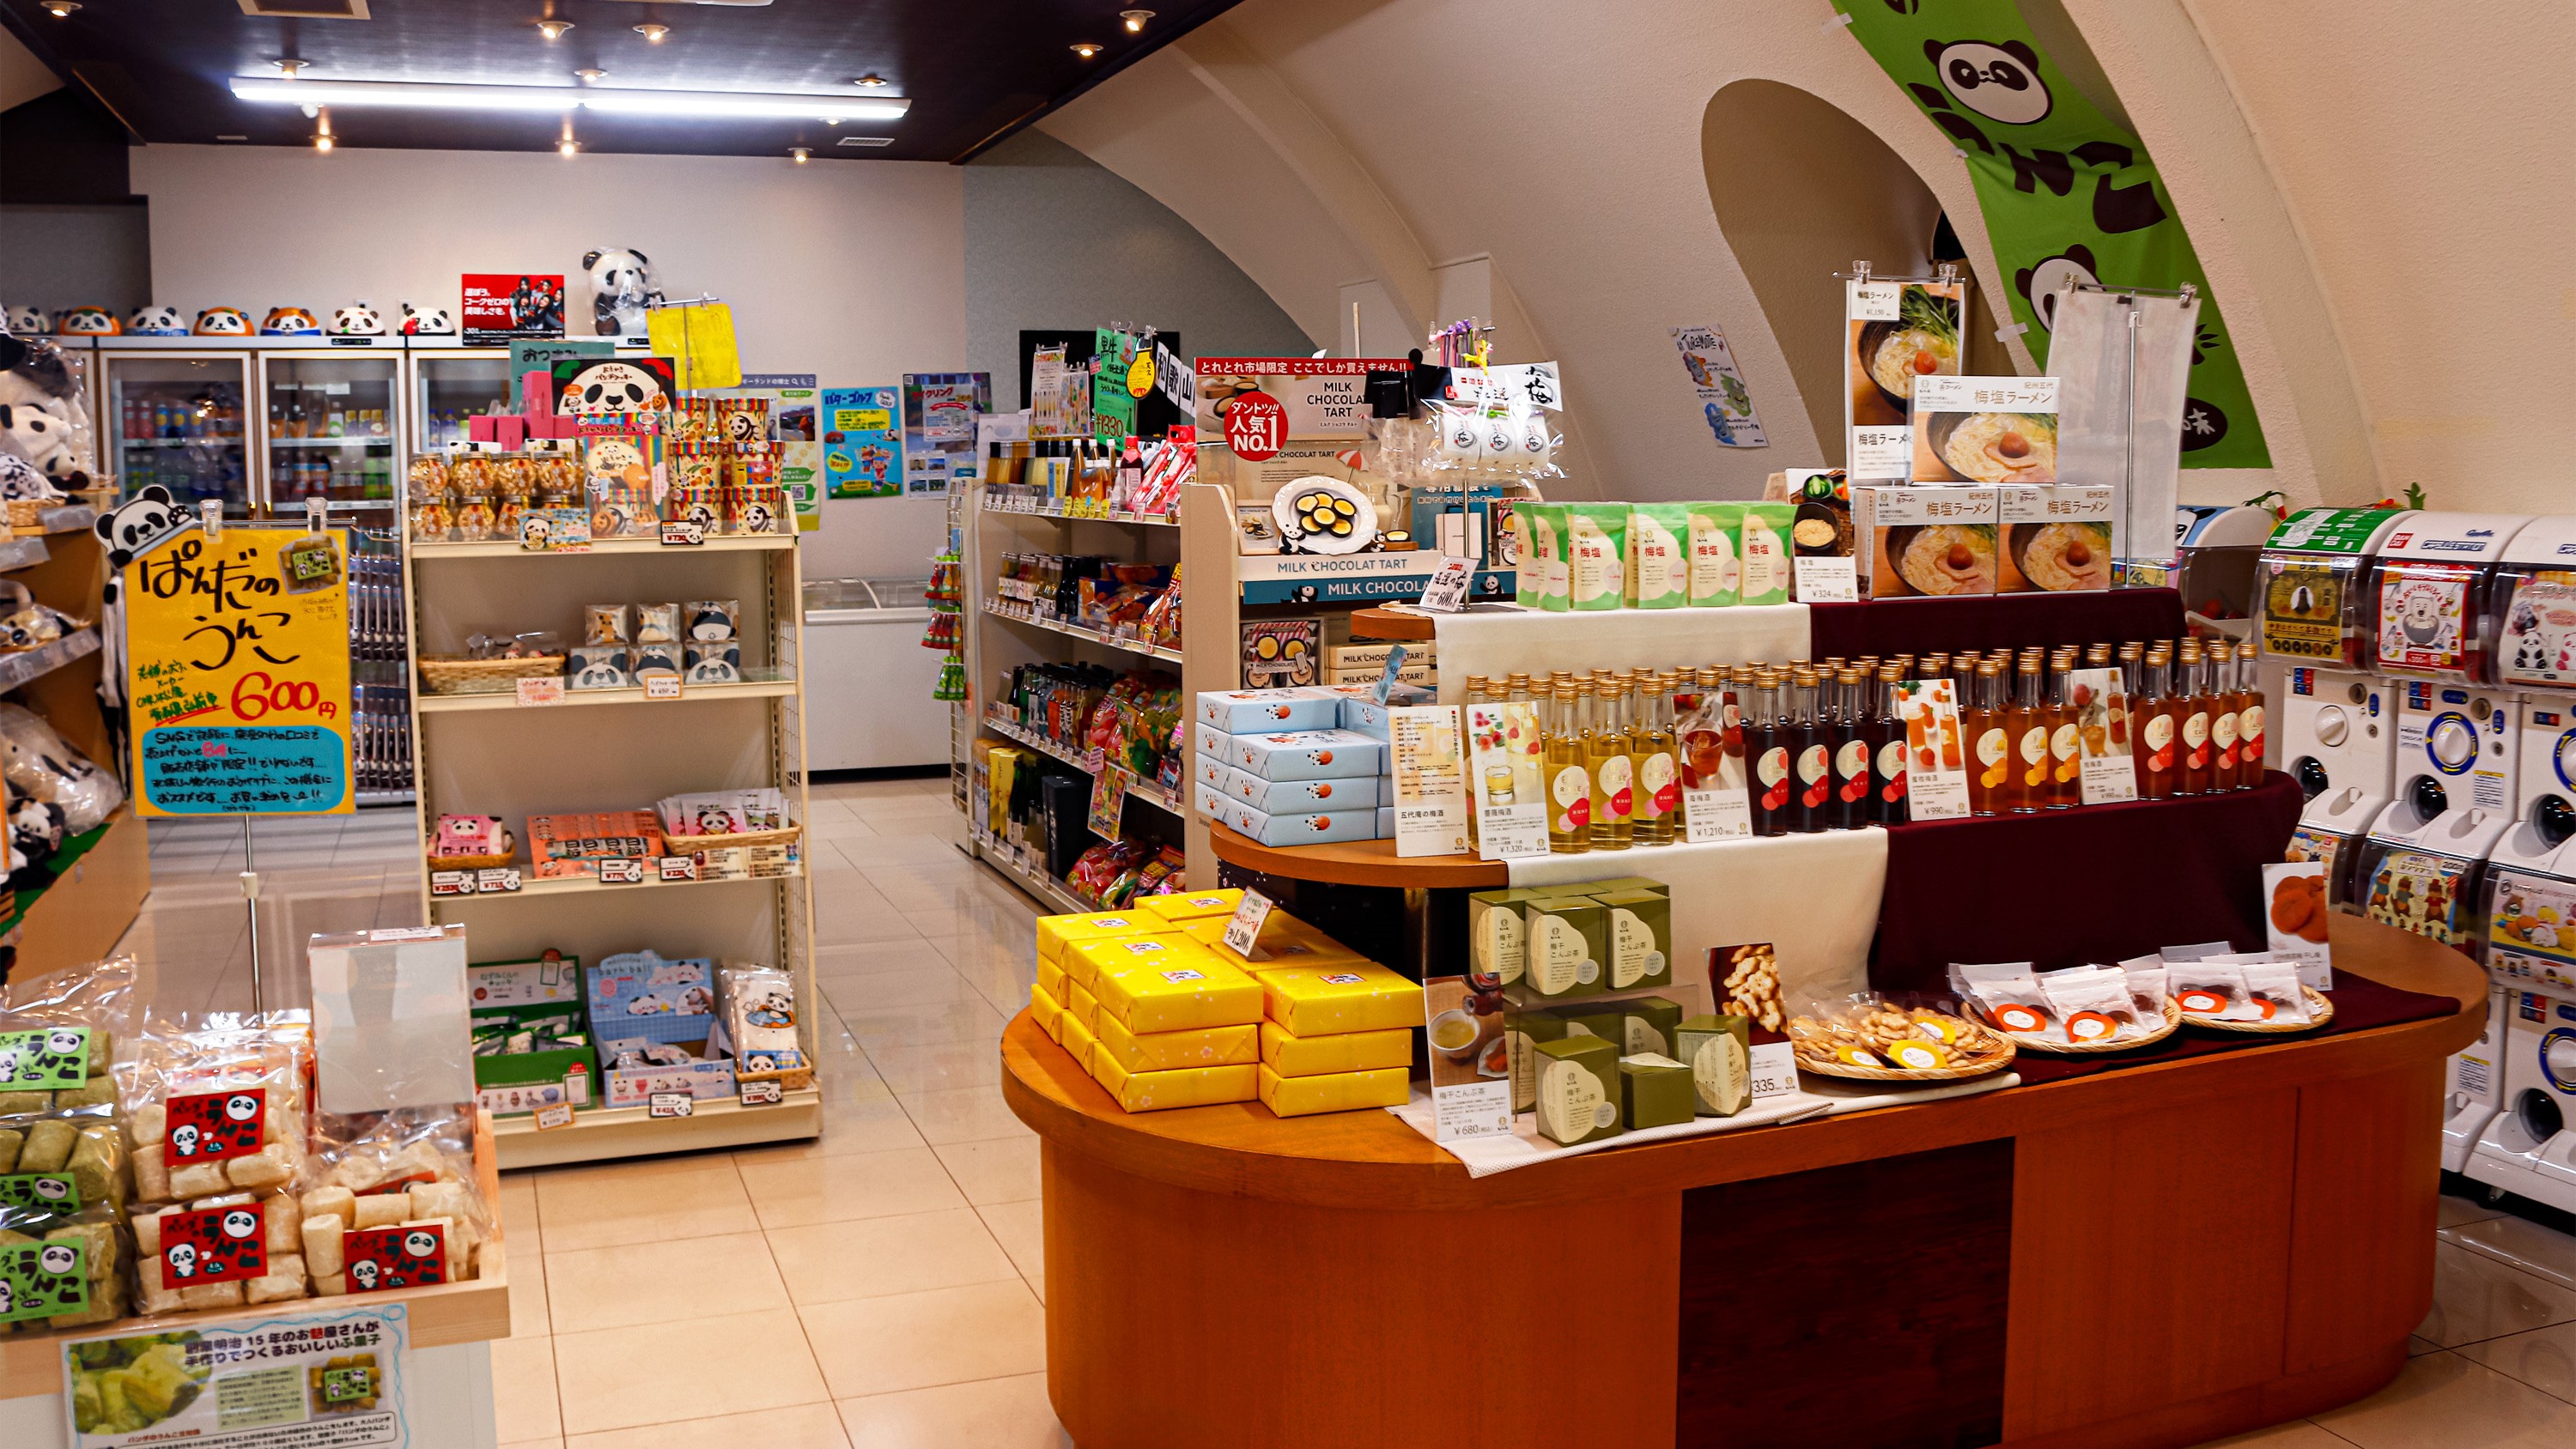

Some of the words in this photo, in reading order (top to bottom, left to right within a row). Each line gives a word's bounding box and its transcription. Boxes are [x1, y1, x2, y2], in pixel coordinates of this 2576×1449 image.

[1857, 291, 1893, 300] 梅塩ラーメン
[1200, 361, 1288, 373] とれとれ市場限定
[1323, 382, 1352, 392] MILK
[824, 391, 873, 406] パターゴルフ
[1307, 394, 1366, 405] CHOCOLA
[1974, 389, 2052, 404] 梅塩ラーメン
[1230, 402, 1279, 415] ダントツ!!
[1323, 407, 1352, 417] TART
[1230, 415, 1267, 433] 人気
[1926, 501, 1992, 516] 梅塩ラーメン
[2047, 500, 2108, 515] 梅塩ラーメン
[1580, 547, 1601, 558] 梅塩
[1644, 546, 1666, 557] 梅塩
[1698, 545, 1718, 555] 梅塩
[1749, 544, 1769, 555] 梅塩
[1278, 562, 1307, 573] MILK
[1311, 560, 1376, 572] CHOCOLAT
[1379, 559, 1407, 569] TART
[139, 539, 280, 613] ぱんだの
[1327, 583, 1362, 596] MILK
[1365, 580, 1430, 594] CHOCOLA
[182, 613, 301, 670] うんこ
[231, 671, 337, 721] 600円
[1400, 809, 1444, 819] 五代庵の梅酒
[1696, 827, 1723, 837] ¥1,210
[1619, 943, 1647, 951] こんぶ茶
[1751, 1078, 1775, 1093] 335
[1439, 1087, 1485, 1100] 梅干こんぶ茶
[1568, 1093, 1596, 1106] こんぶ茶
[206, 1100, 258, 1147] うんこ
[1454, 1125, 1479, 1136] ¥680
[203, 1216, 260, 1268] うんこ
[385, 1234, 439, 1282] うんこ
[17, 1250, 82, 1303] うんこ
[246, 1336, 264, 1346] 15
